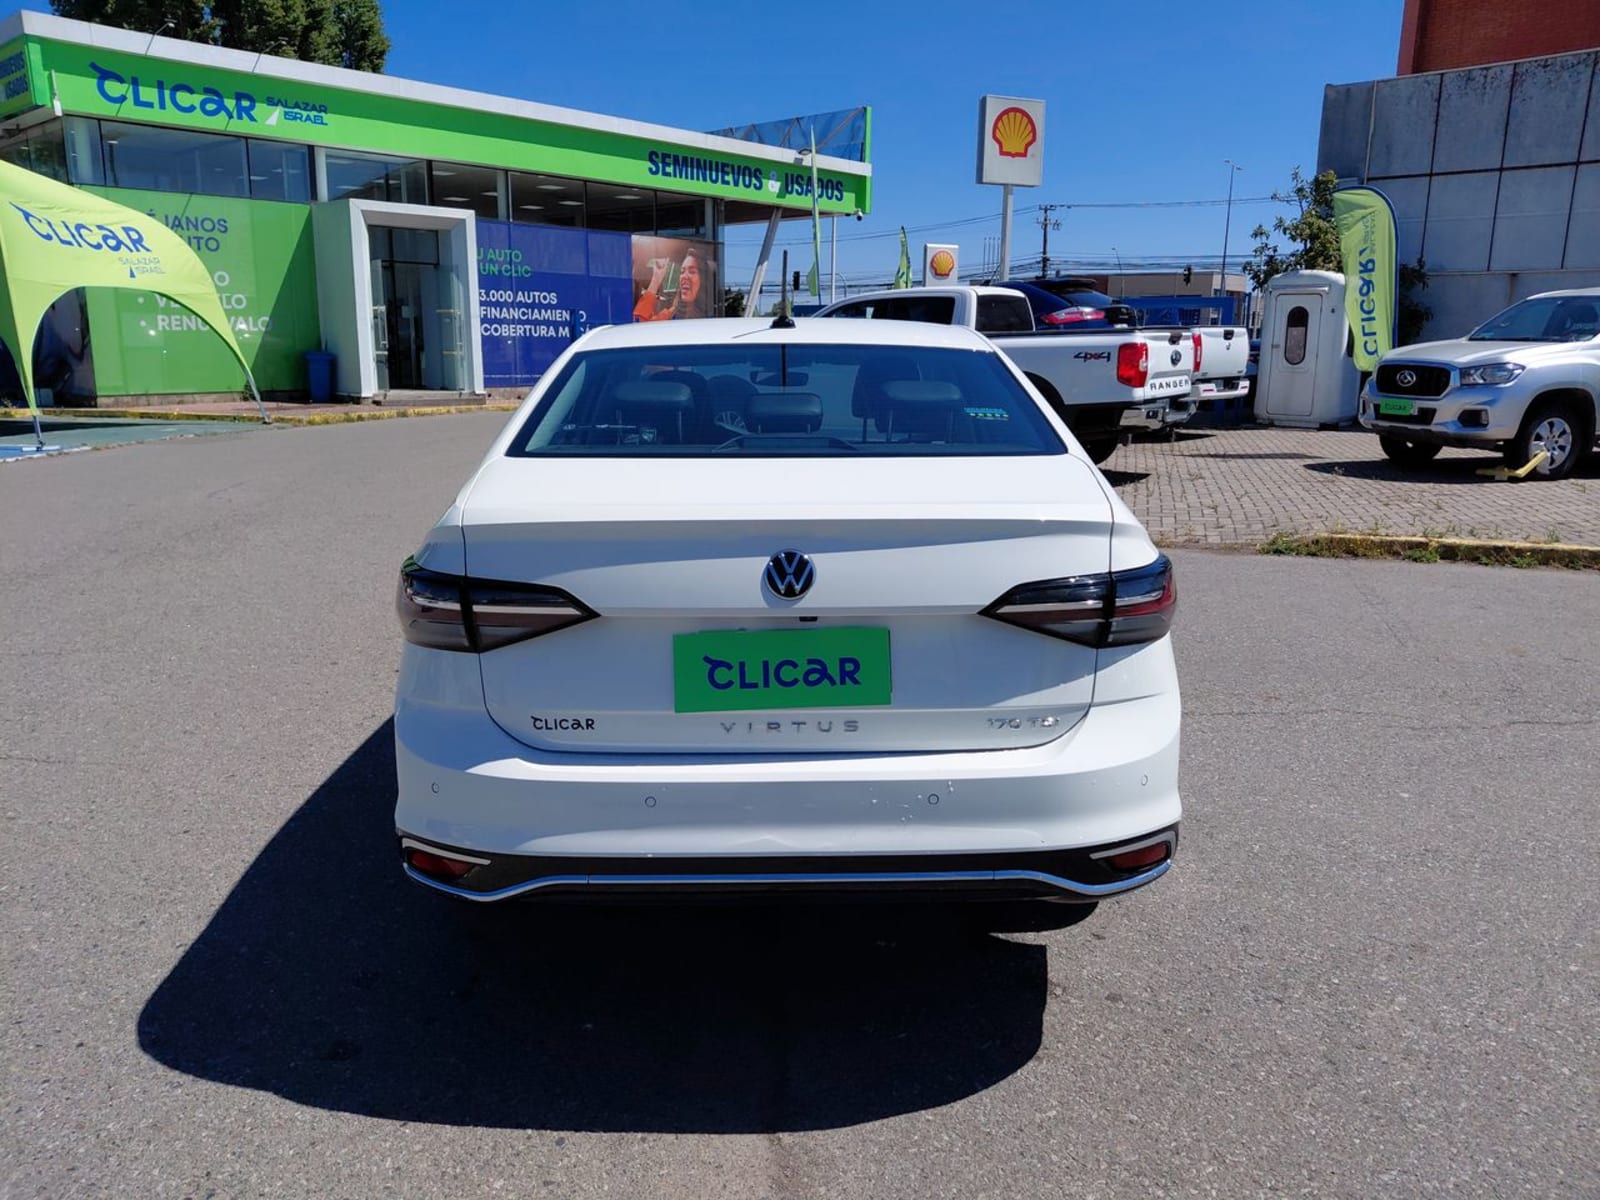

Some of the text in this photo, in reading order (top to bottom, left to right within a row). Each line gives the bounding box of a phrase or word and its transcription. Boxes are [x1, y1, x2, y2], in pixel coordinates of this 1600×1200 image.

[89, 62, 257, 122] CLICAR
[266, 96, 328, 114] SALAZAR
[284, 110, 328, 126] ISRAEL
[648, 150, 763, 191] SEMINUEVOS
[9, 202, 152, 252] CLICAR
[487, 248, 522, 262] AUTO
[480, 262, 531, 277] UN CLIC
[480, 289, 557, 304] 3.000 AUTOS
[481, 323, 556, 338] COBERTURA
[1073, 351, 1111, 363] 4x4
[1150, 379, 1189, 391] RANGER
[703, 655, 861, 690] CLICAR
[530, 715, 595, 730] CLICAR
[720, 720, 860, 733] VIRTUS
[988, 718, 1021, 729] 170
